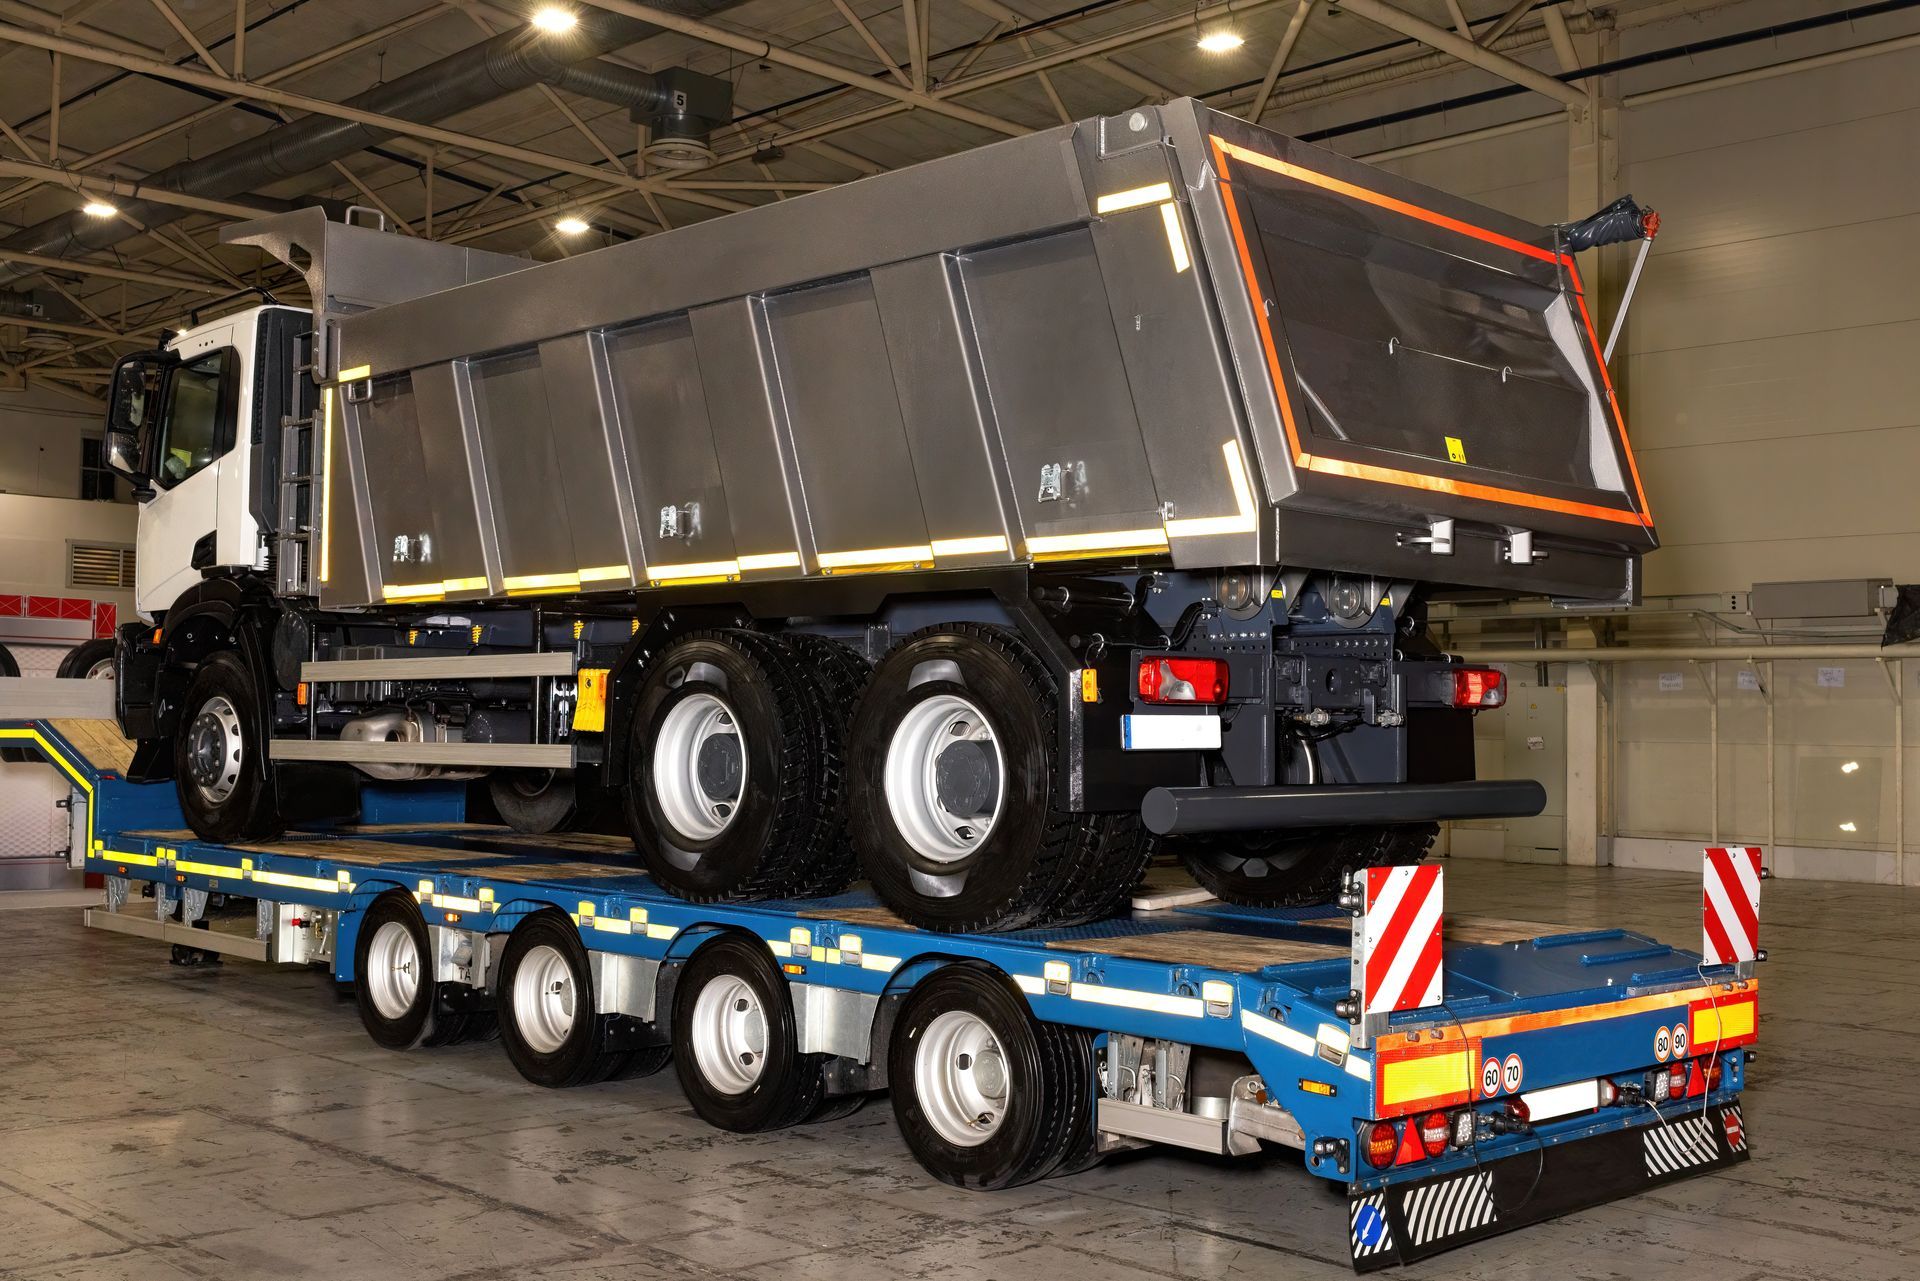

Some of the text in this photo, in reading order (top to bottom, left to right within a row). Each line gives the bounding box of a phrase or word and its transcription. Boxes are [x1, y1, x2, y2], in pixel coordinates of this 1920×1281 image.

[676, 94, 684, 106] 5
[34, 305, 41, 313] 7
[1657, 1036, 1669, 1052] 80
[1674, 1033, 1686, 1049] 90
[1485, 1069, 1498, 1087] 60
[1507, 1065, 1519, 1083] 70
